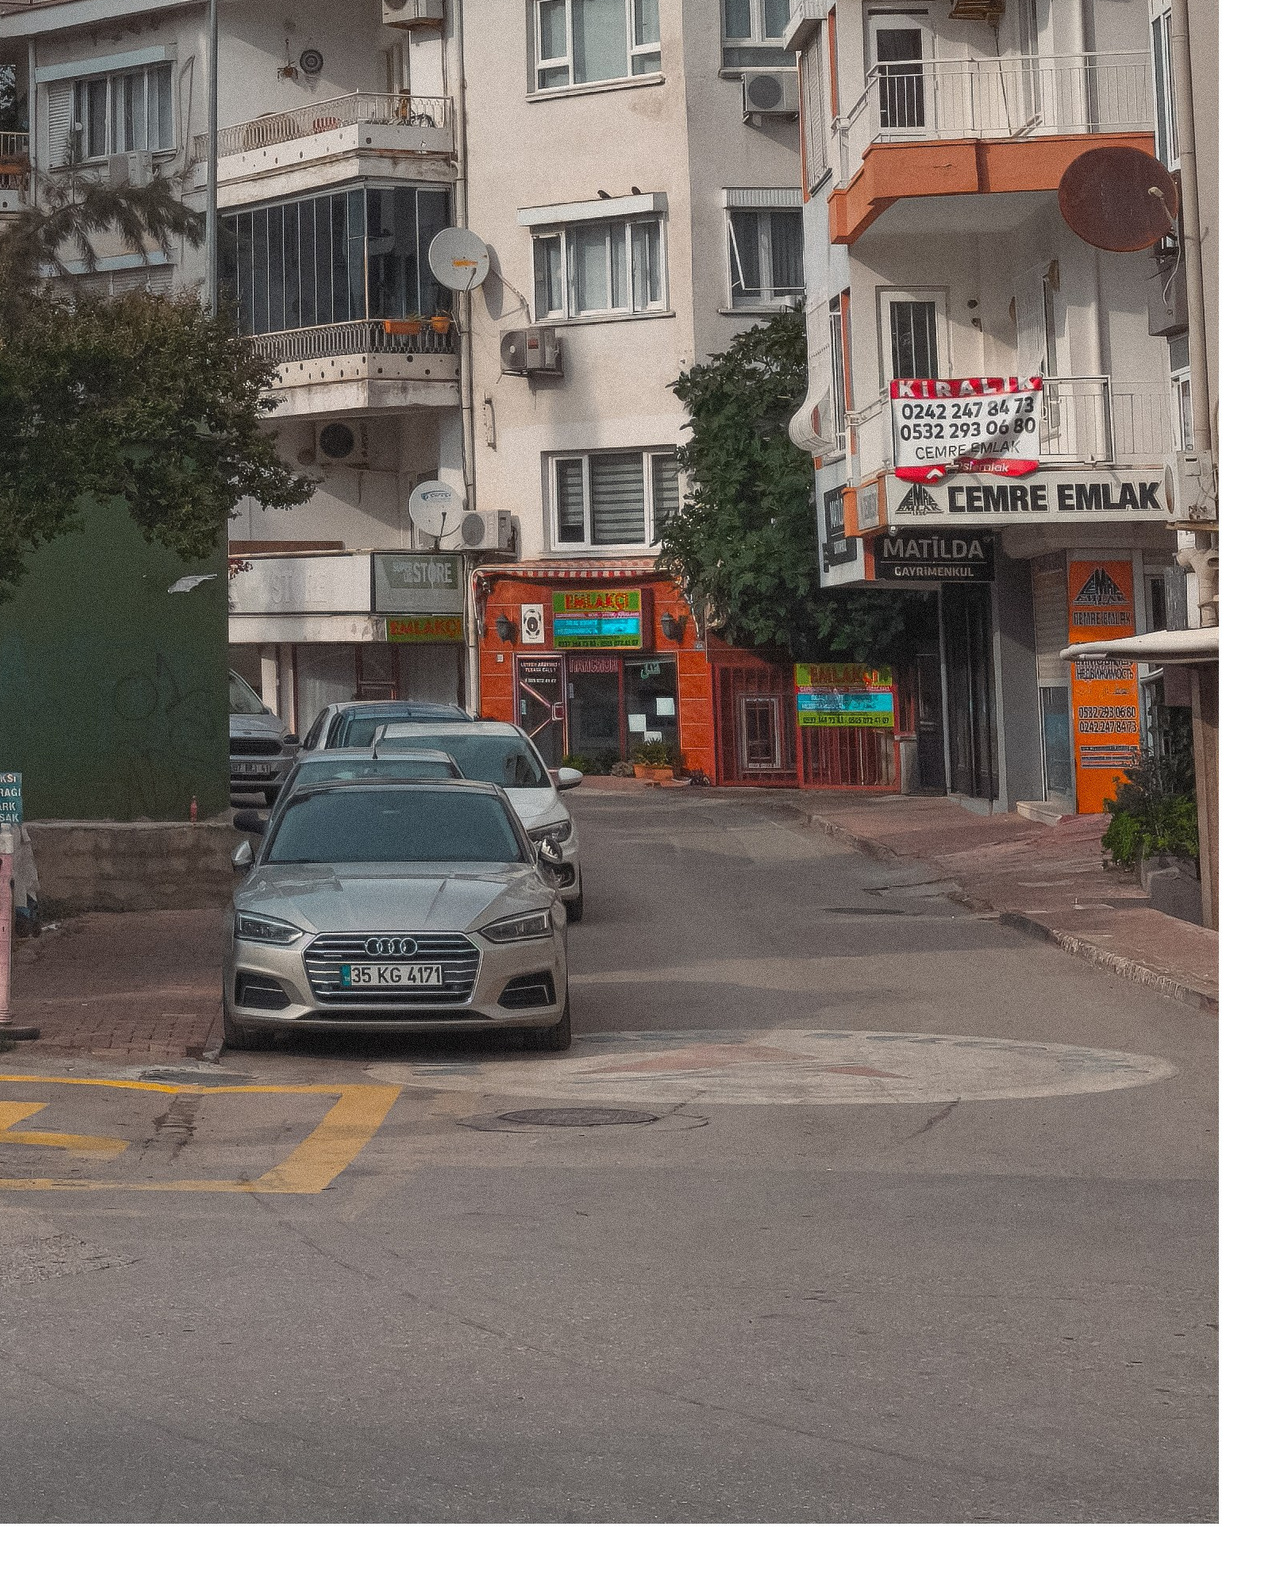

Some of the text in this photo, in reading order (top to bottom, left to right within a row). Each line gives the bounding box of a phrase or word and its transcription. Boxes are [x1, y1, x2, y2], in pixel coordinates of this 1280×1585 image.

[901, 396, 1035, 420] 0242 247 84 73
[900, 417, 1036, 441] 0532 293 06 80
[915, 440, 1021, 460] CEMRE EMLAK
[947, 481, 1164, 512] CEMRE EMLAK
[1079, 706, 1098, 718] 0532
[1079, 721, 1099, 732] 0242
[351, 966, 441, 984] 35 KG 4171
